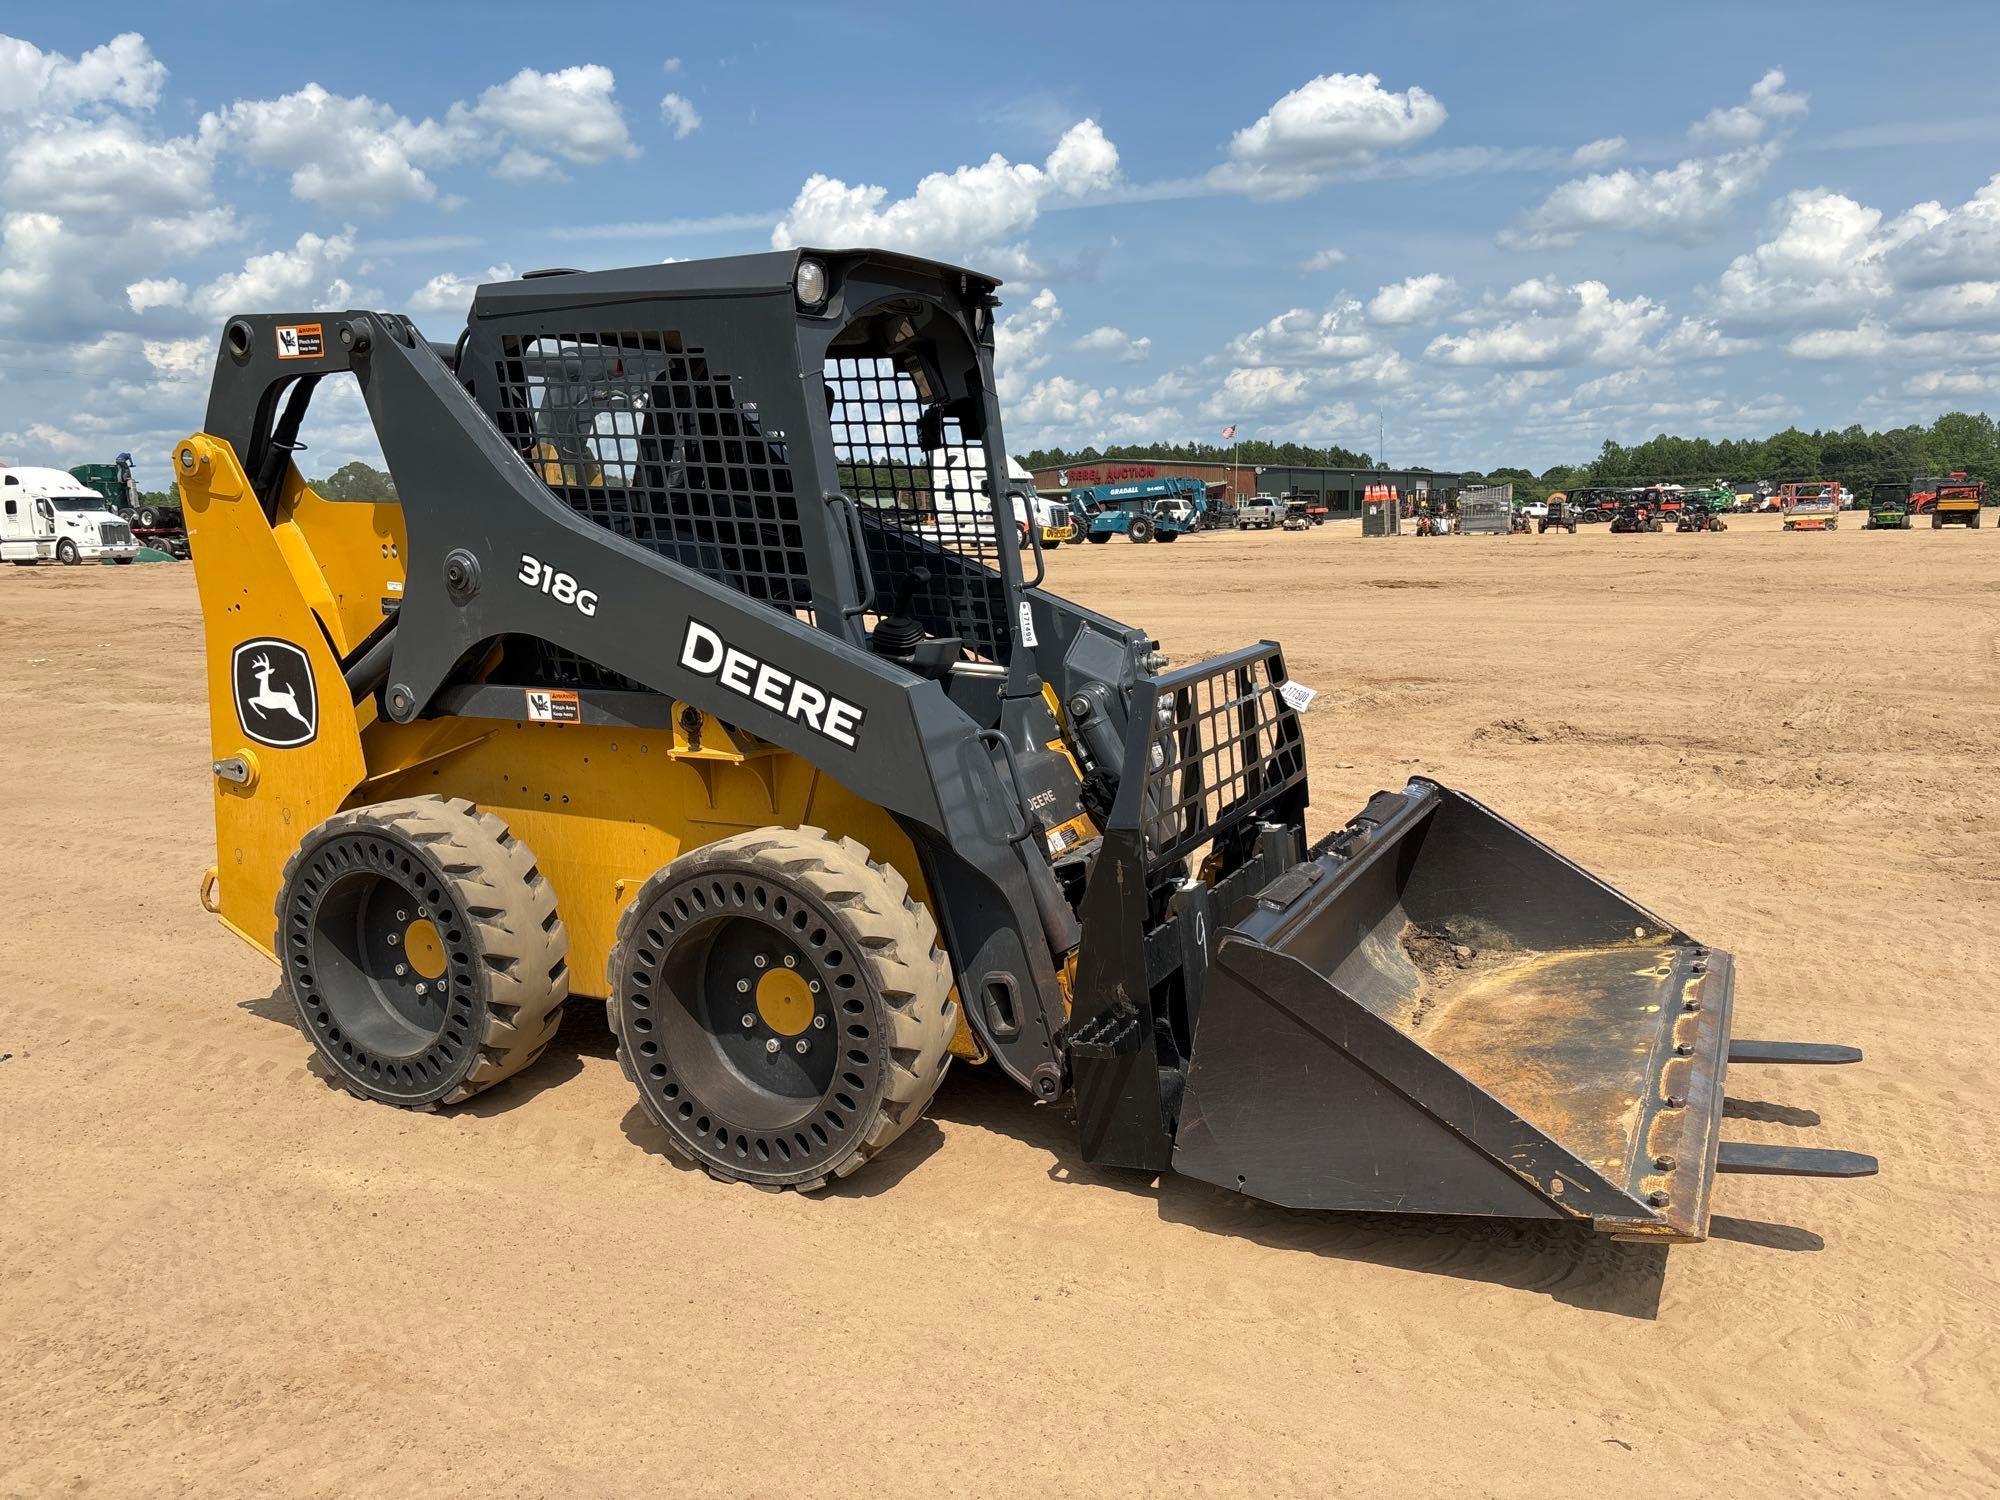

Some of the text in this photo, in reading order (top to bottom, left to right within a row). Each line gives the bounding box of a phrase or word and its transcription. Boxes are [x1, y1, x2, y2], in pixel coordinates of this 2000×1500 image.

[1069, 467, 1156, 481] REBEL AUCTION
[1110, 486, 1139, 495] GRADALL
[518, 554, 598, 617] 318G
[1023, 612, 1033, 642] 171499
[681, 620, 863, 747] DEERE
[1196, 911, 1209, 969] 9
